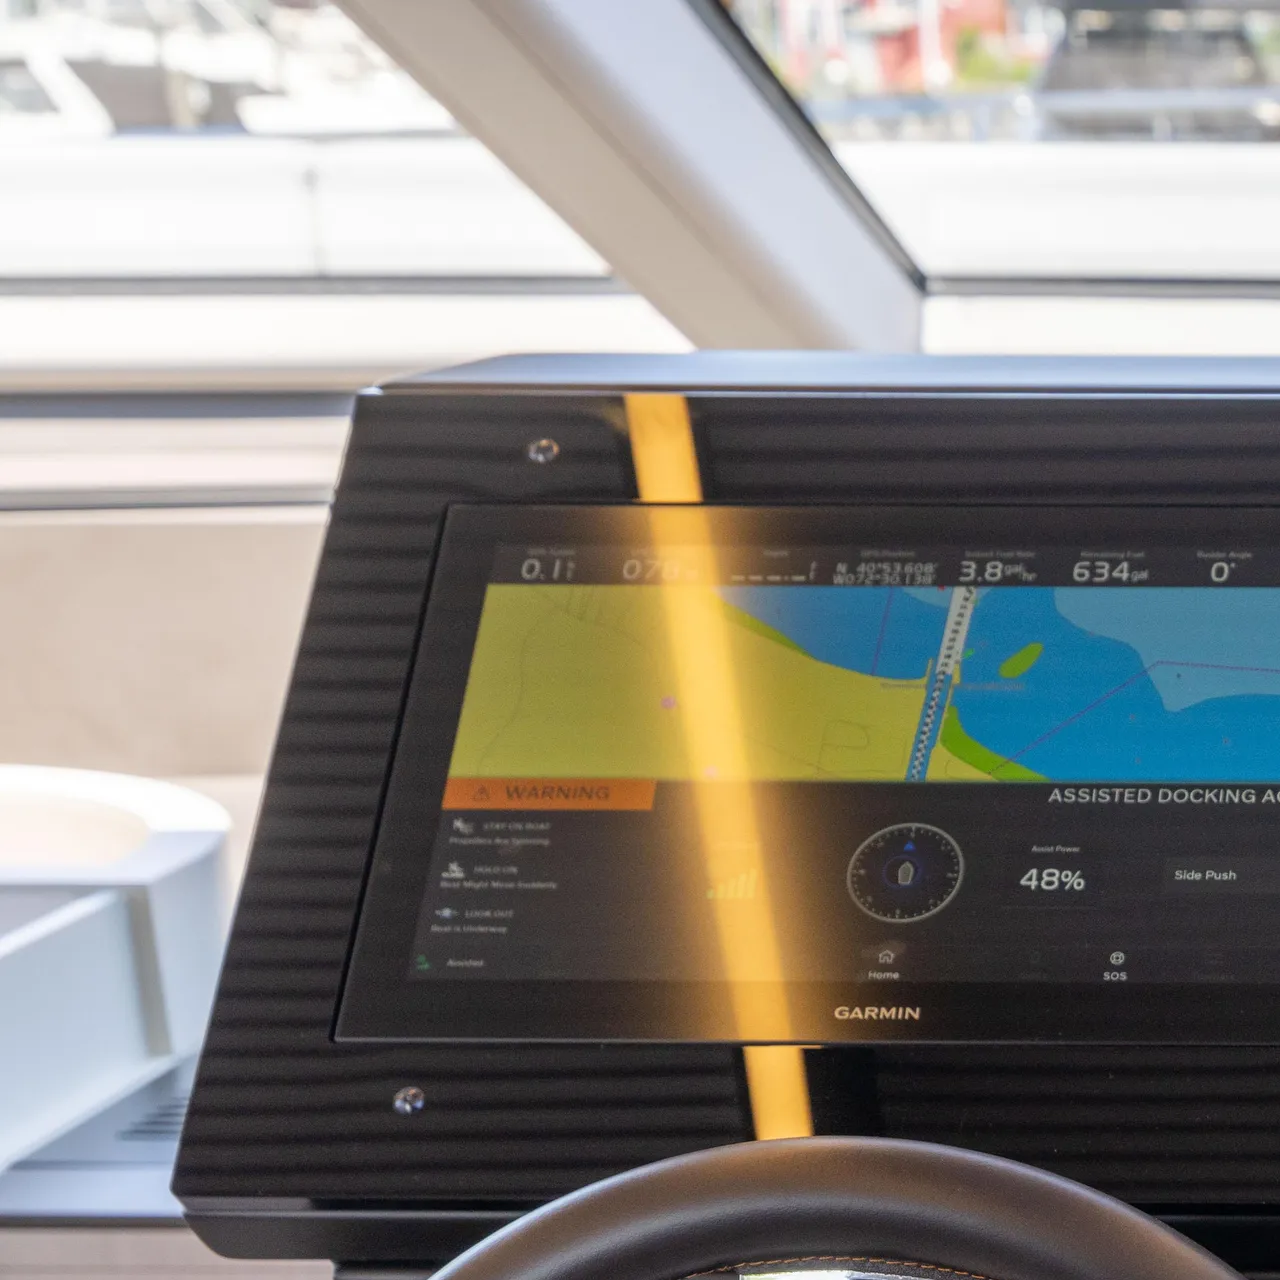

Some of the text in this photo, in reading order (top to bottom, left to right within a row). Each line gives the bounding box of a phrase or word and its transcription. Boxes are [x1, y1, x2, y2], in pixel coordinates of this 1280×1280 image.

[959, 561, 1003, 582] 3.8
[505, 786, 610, 800] WARNING
[1049, 788, 1151, 803] ASSISTED
[1158, 788, 1256, 803] DOCKING
[1020, 868, 1086, 891] 48%
[1175, 870, 1237, 881] Side Push
[868, 971, 899, 980] Home
[1103, 971, 1128, 981] SOS
[834, 1007, 921, 1020] GARMIN
